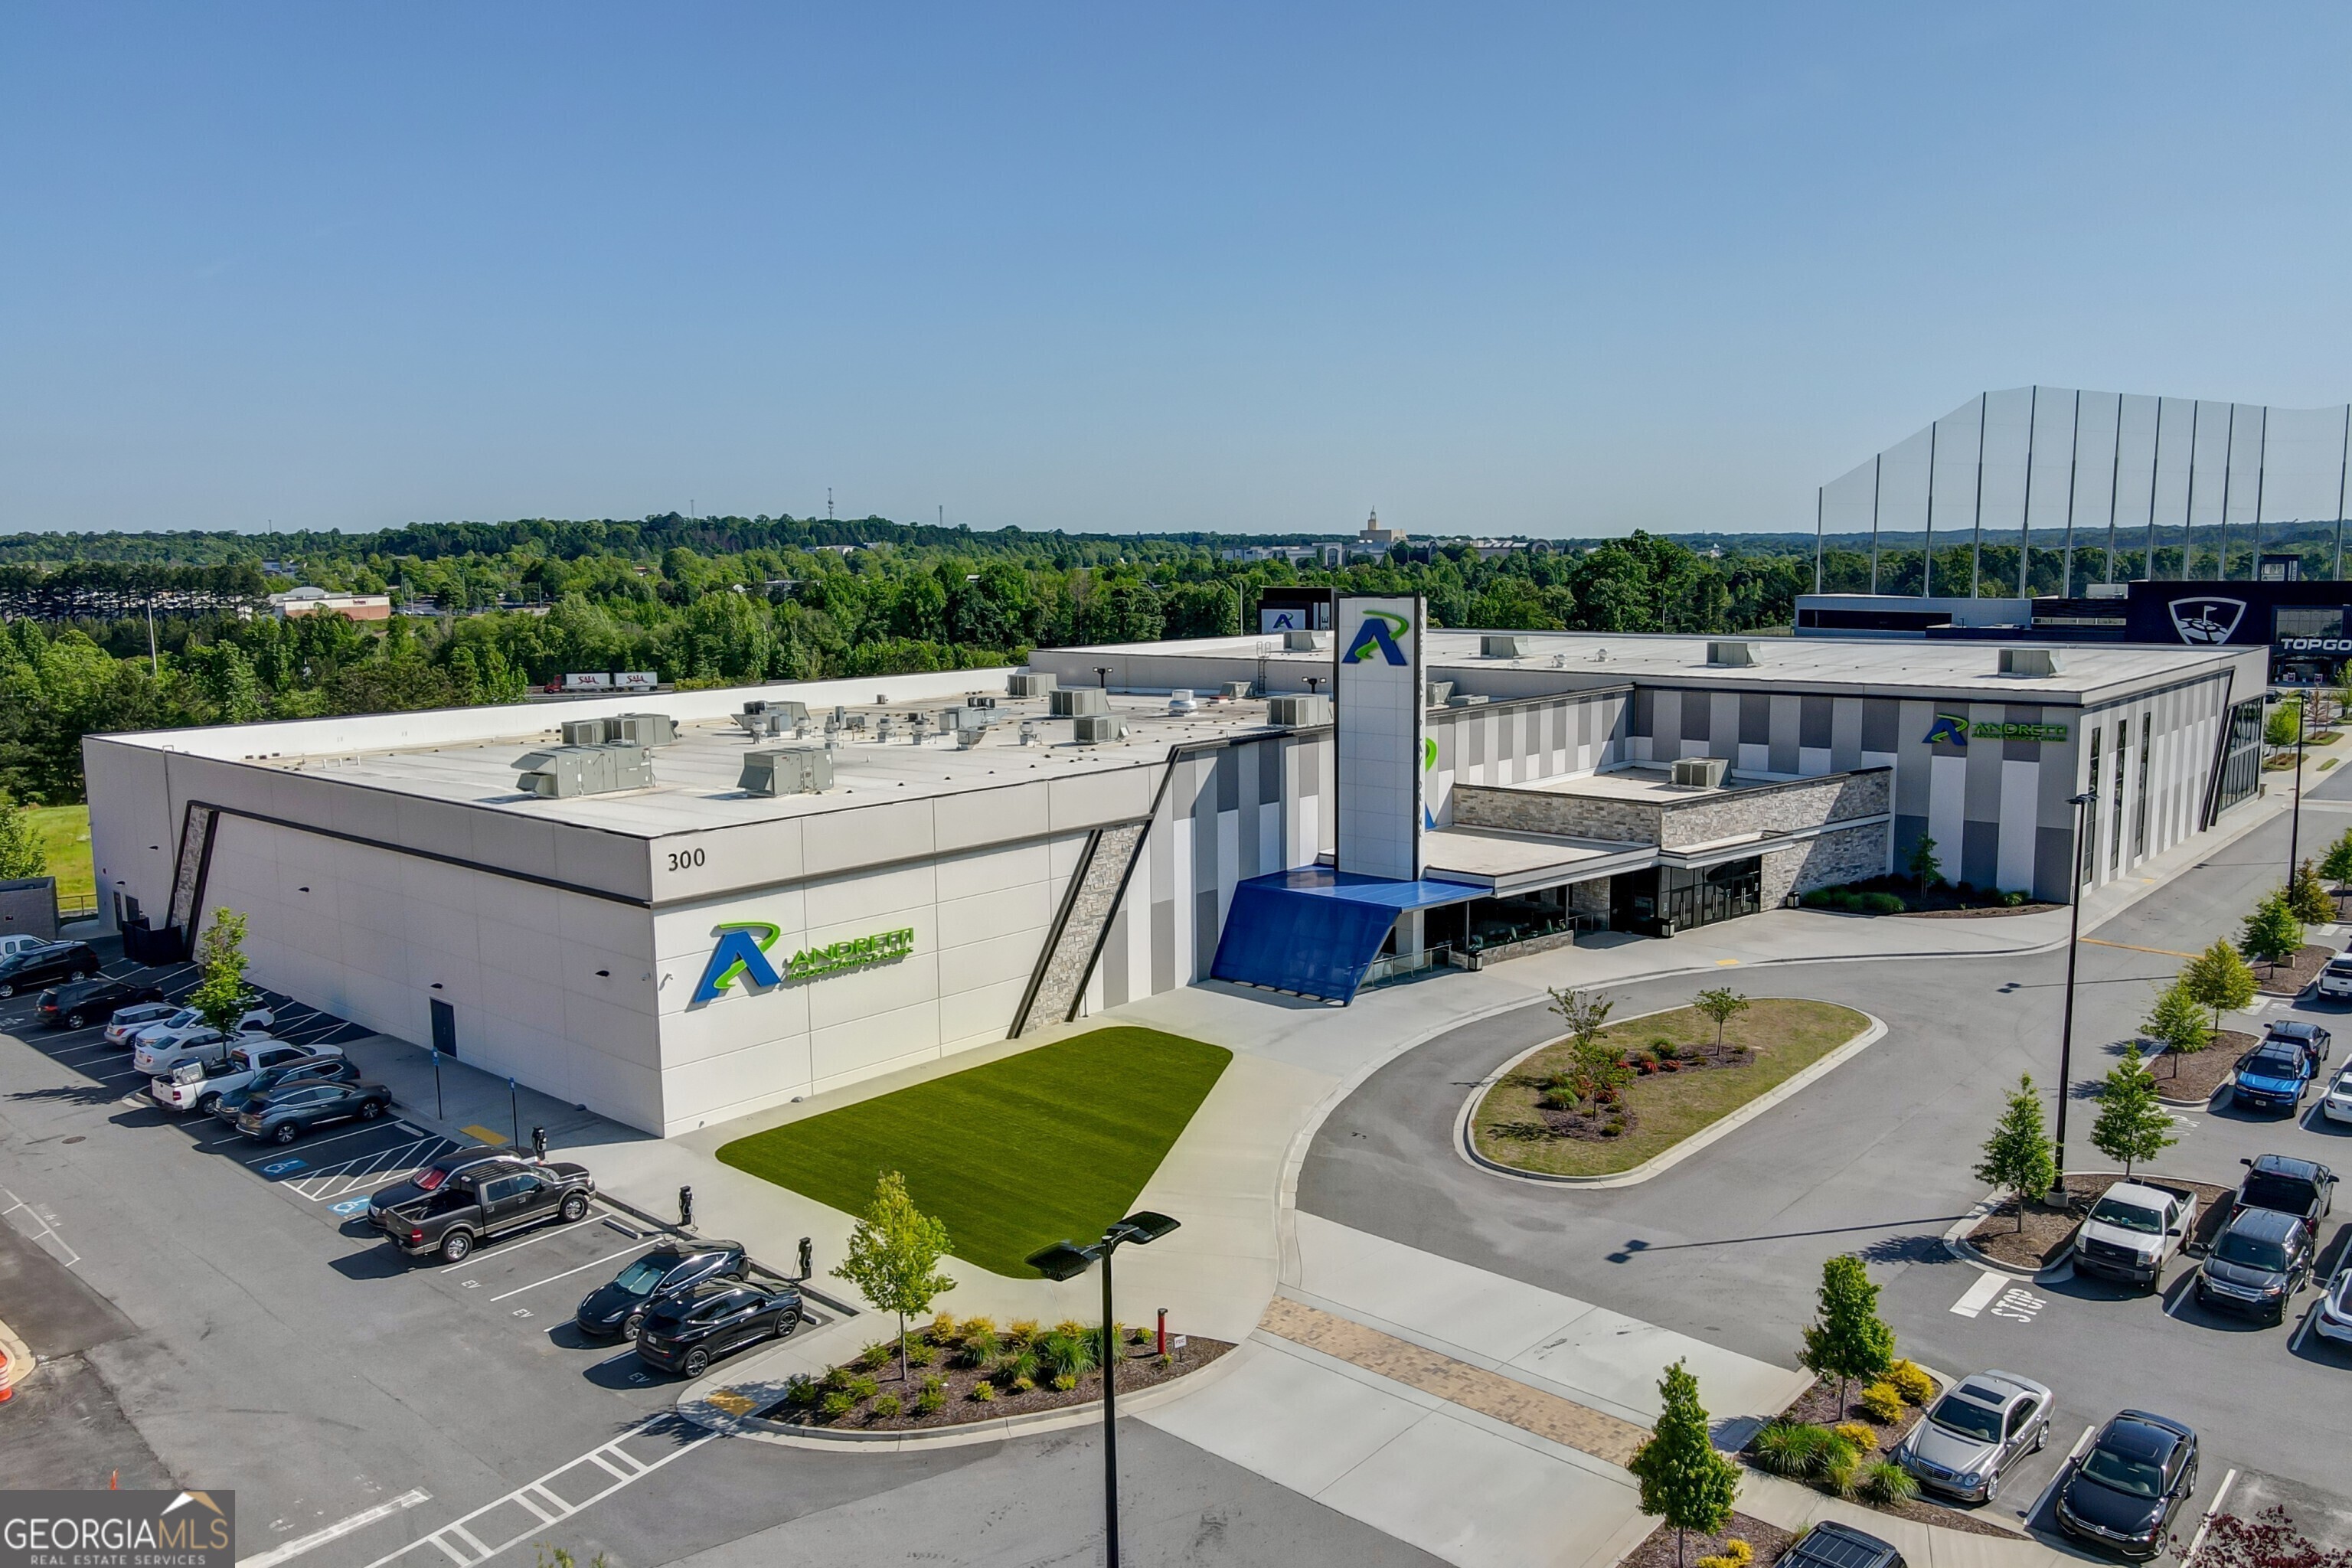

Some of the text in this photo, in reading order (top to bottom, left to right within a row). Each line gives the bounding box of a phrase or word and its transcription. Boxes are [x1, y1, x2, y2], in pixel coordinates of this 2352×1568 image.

[668, 847, 705, 871] 300
[790, 927, 914, 970] ANDRETTI
[789, 966, 830, 981] INDOOR
[831, 956, 871, 972] KARTING
[882, 946, 914, 959] GAMES
[461, 1279, 482, 1289] EV
[512, 1308, 534, 1318] EV
[1991, 1288, 2047, 1323] STOP
[628, 1372, 650, 1383] EV
